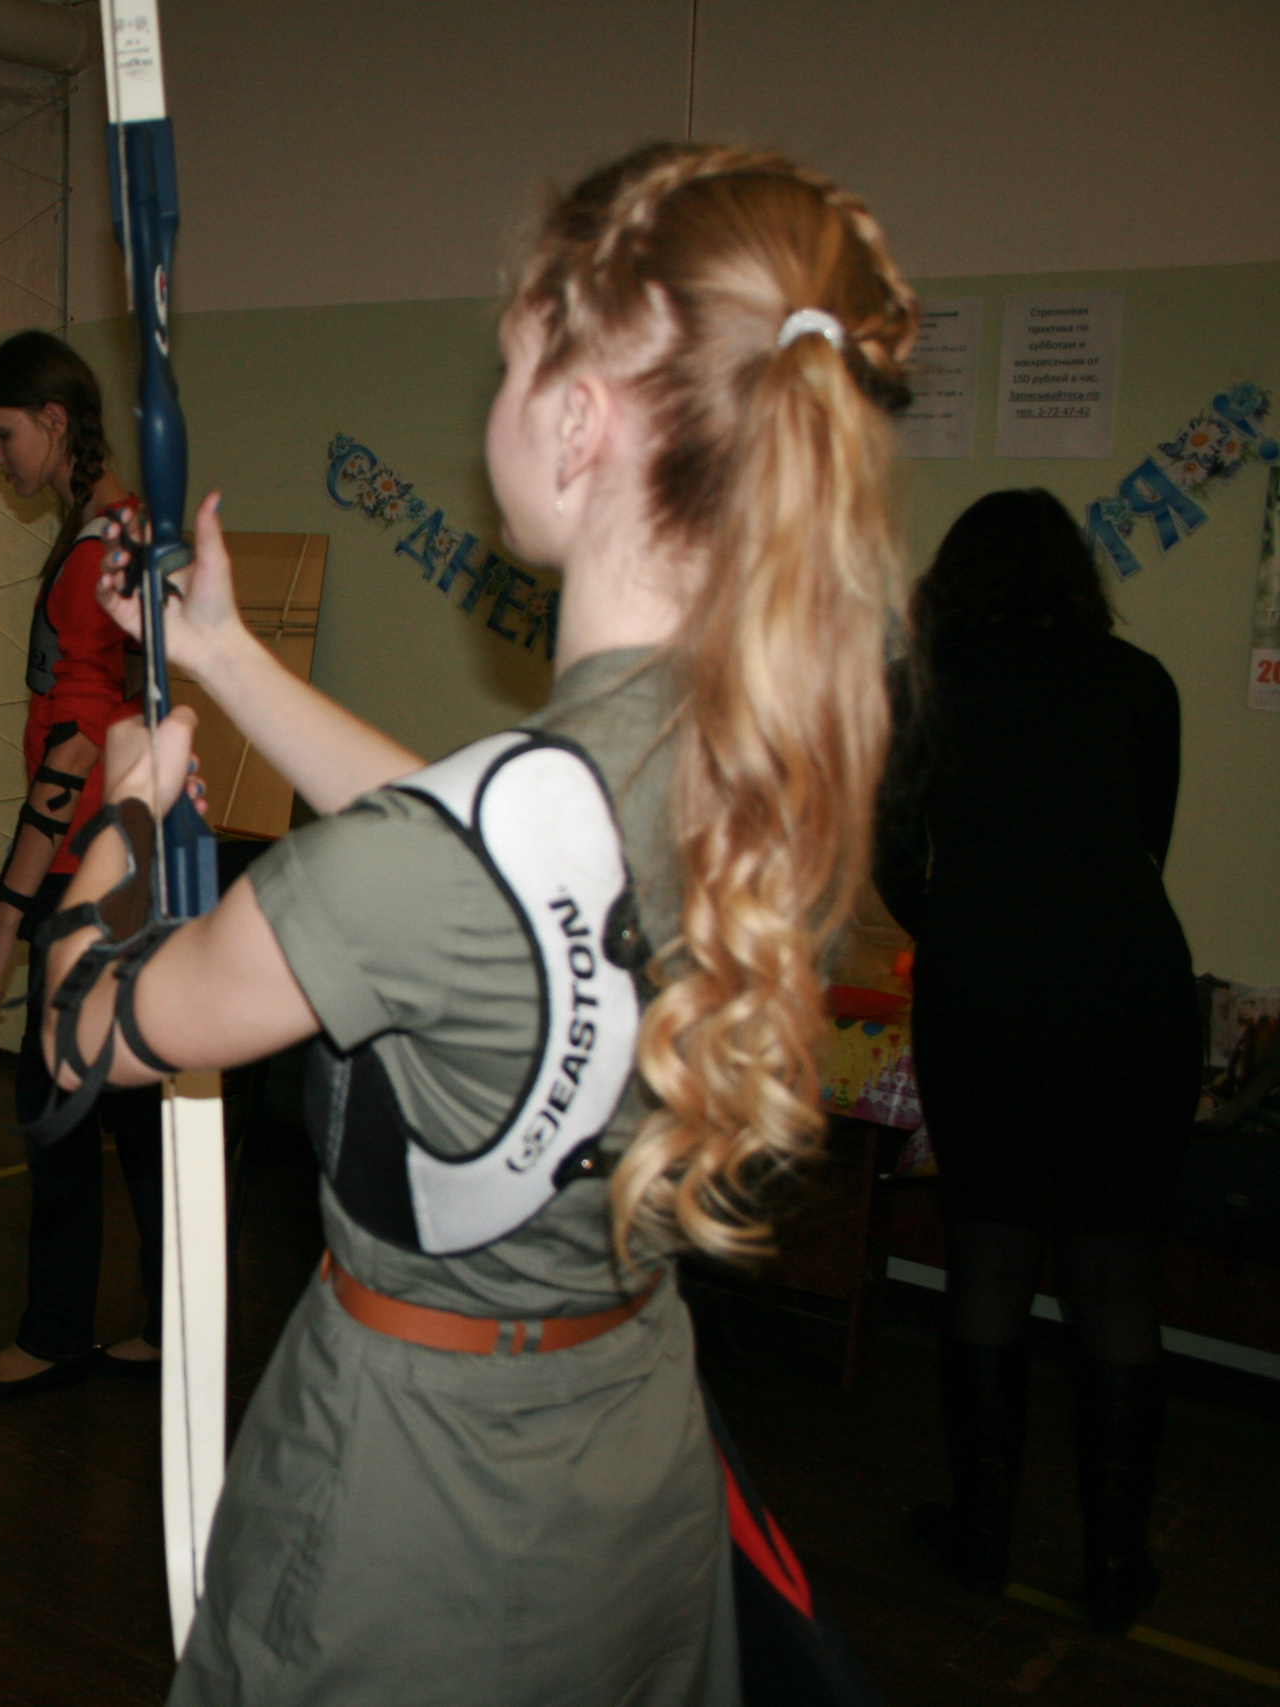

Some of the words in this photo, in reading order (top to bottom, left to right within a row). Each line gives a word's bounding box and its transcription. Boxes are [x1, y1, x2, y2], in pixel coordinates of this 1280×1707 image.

[1027, 325, 1073, 334] практика
[1075, 324, 1089, 332] по
[1028, 340, 1076, 351] субботам
[1012, 375, 1030, 384] 150
[1032, 373, 1068, 385] рублей
[1086, 391, 1100, 400] по
[549, 897, 600, 1115] EASTON
